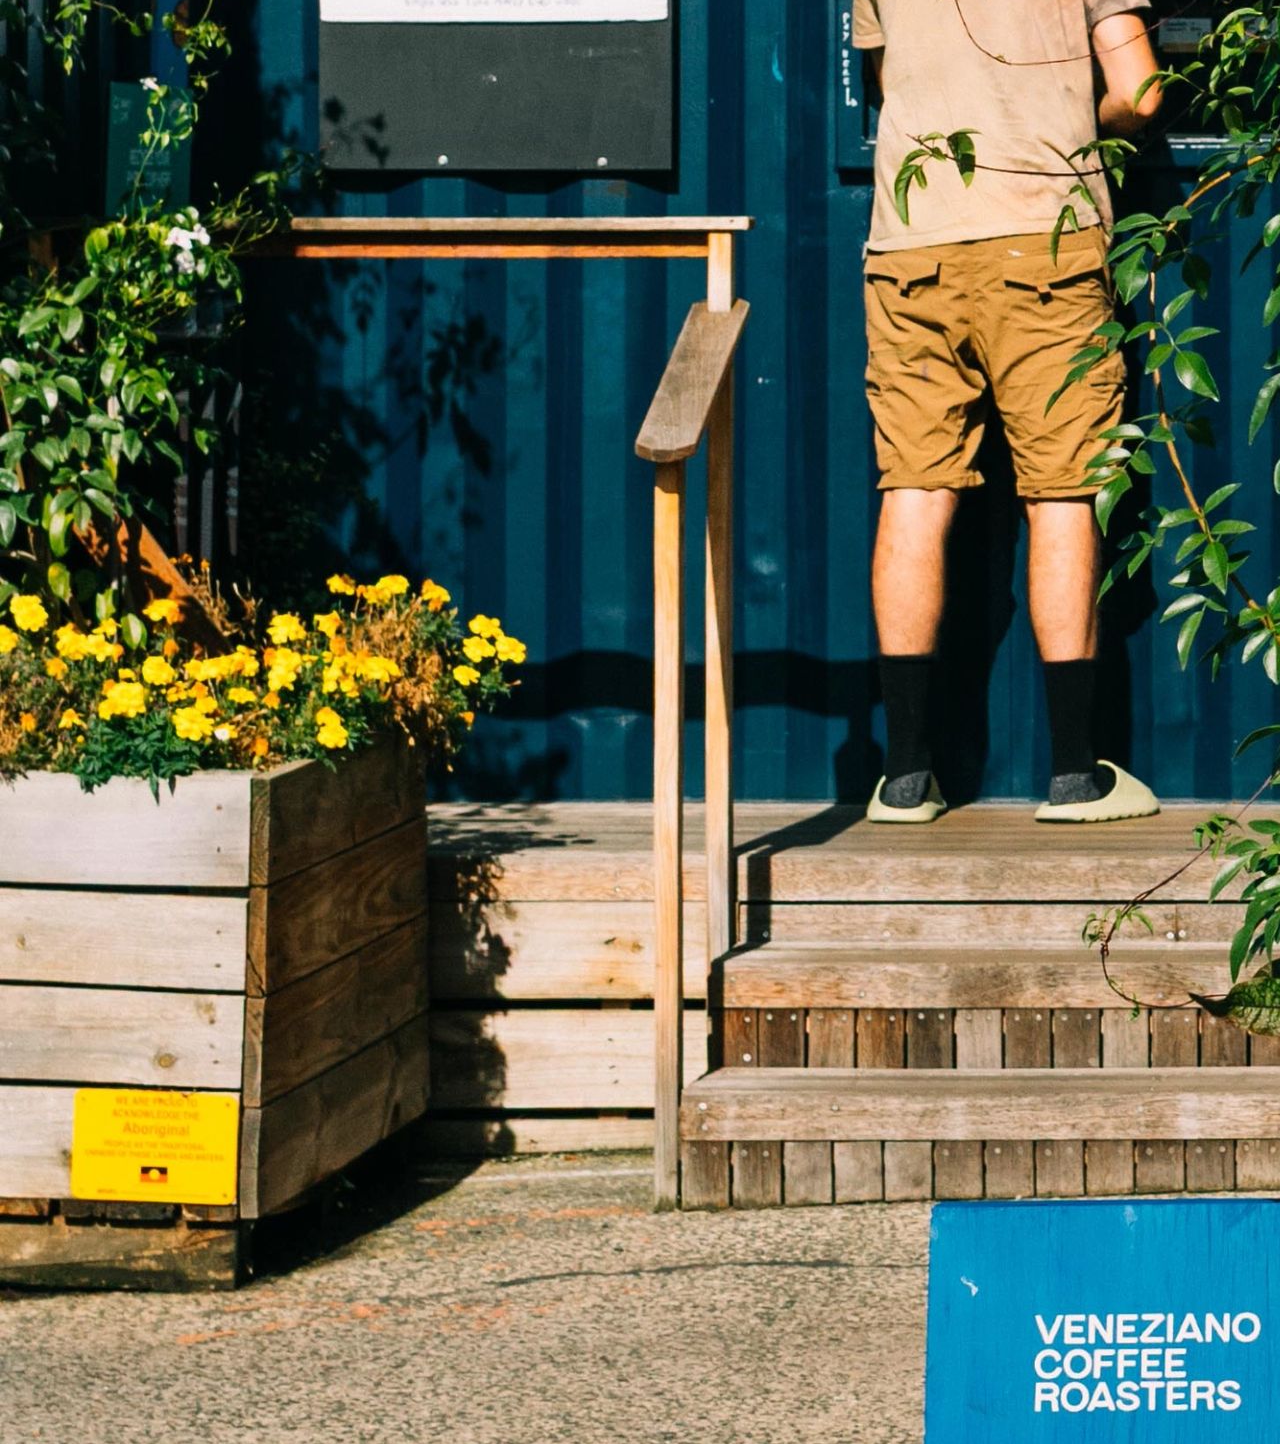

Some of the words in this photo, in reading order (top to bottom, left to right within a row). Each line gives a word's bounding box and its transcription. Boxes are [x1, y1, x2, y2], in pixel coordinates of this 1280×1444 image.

[112, 1109, 181, 1120] ACKNOWLEDGE
[184, 1111, 200, 1122] THE
[123, 1121, 190, 1138] Aboriginal
[1036, 1313, 1260, 1344] VENEZIANO
[1035, 1349, 1186, 1379] COFFEE
[1035, 1381, 1241, 1412] ROASTERS
